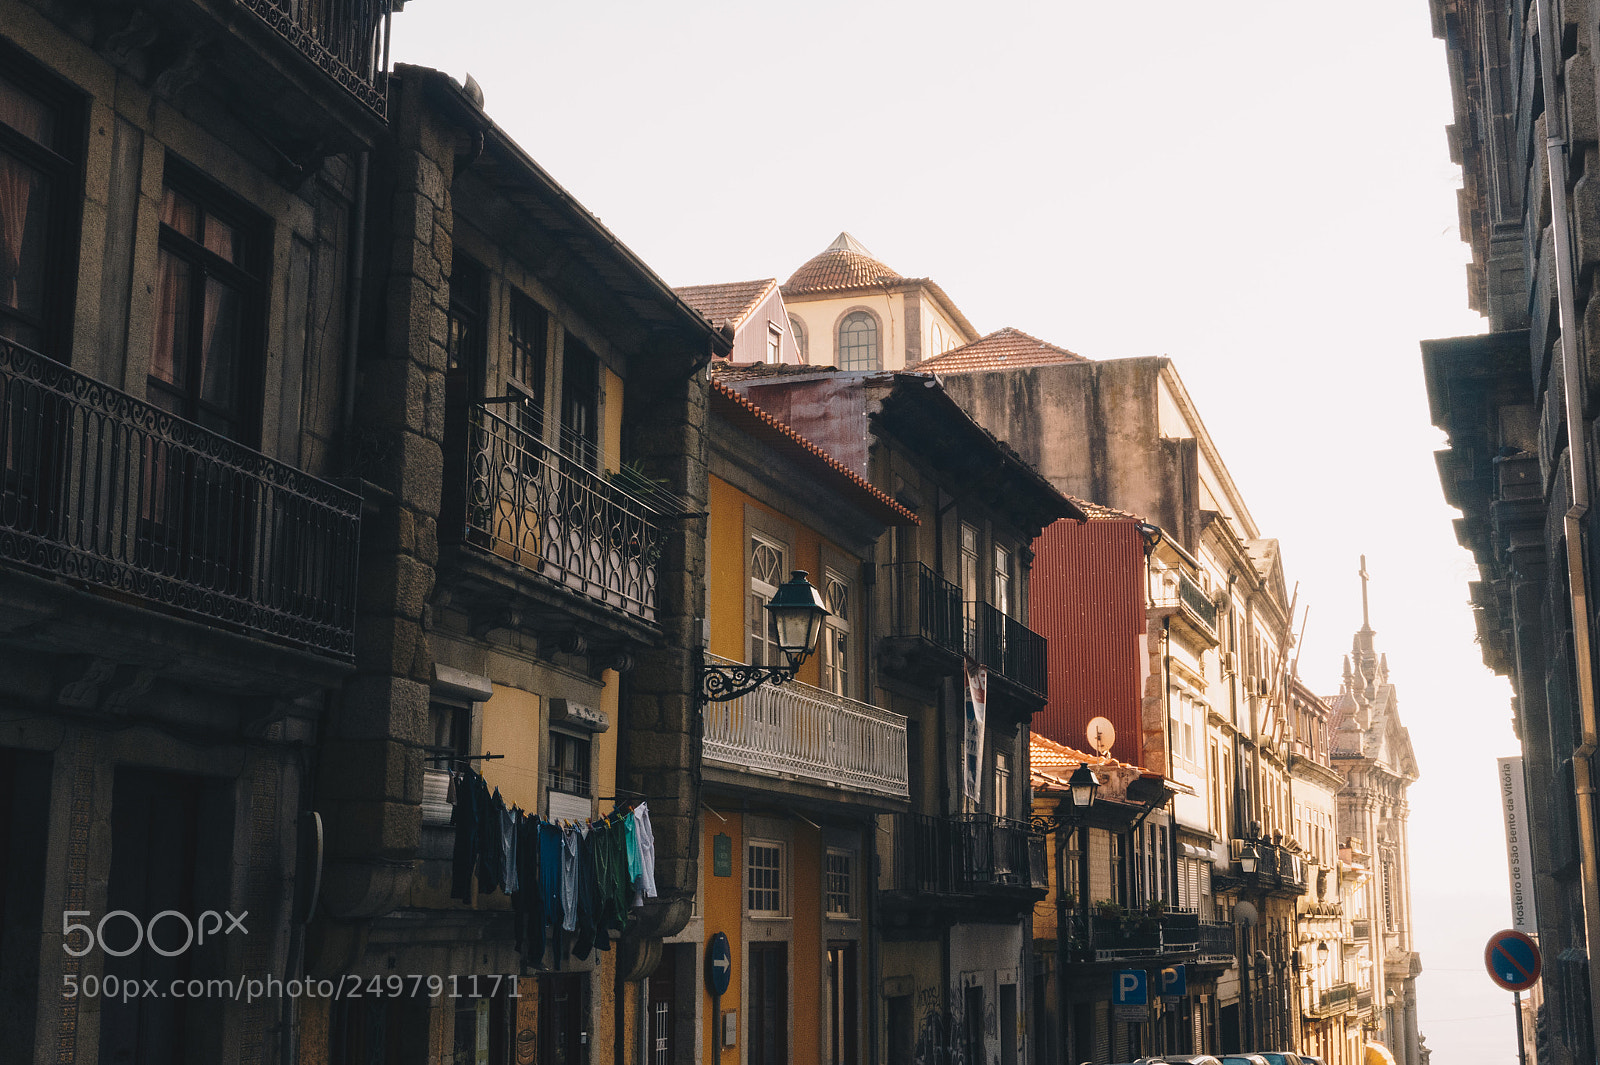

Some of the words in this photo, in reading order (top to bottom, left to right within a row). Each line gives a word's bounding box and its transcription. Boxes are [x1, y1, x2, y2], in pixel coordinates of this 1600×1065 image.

[1502, 763, 1513, 797] Vitória
[1506, 798, 1514, 811] da
[1508, 813, 1518, 844] Bento
[1510, 845, 1519, 865] São
[1512, 867, 1521, 880] de
[1514, 882, 1525, 926] Mosteiro
[1119, 973, 1139, 1001] P
[1161, 967, 1179, 992] P
